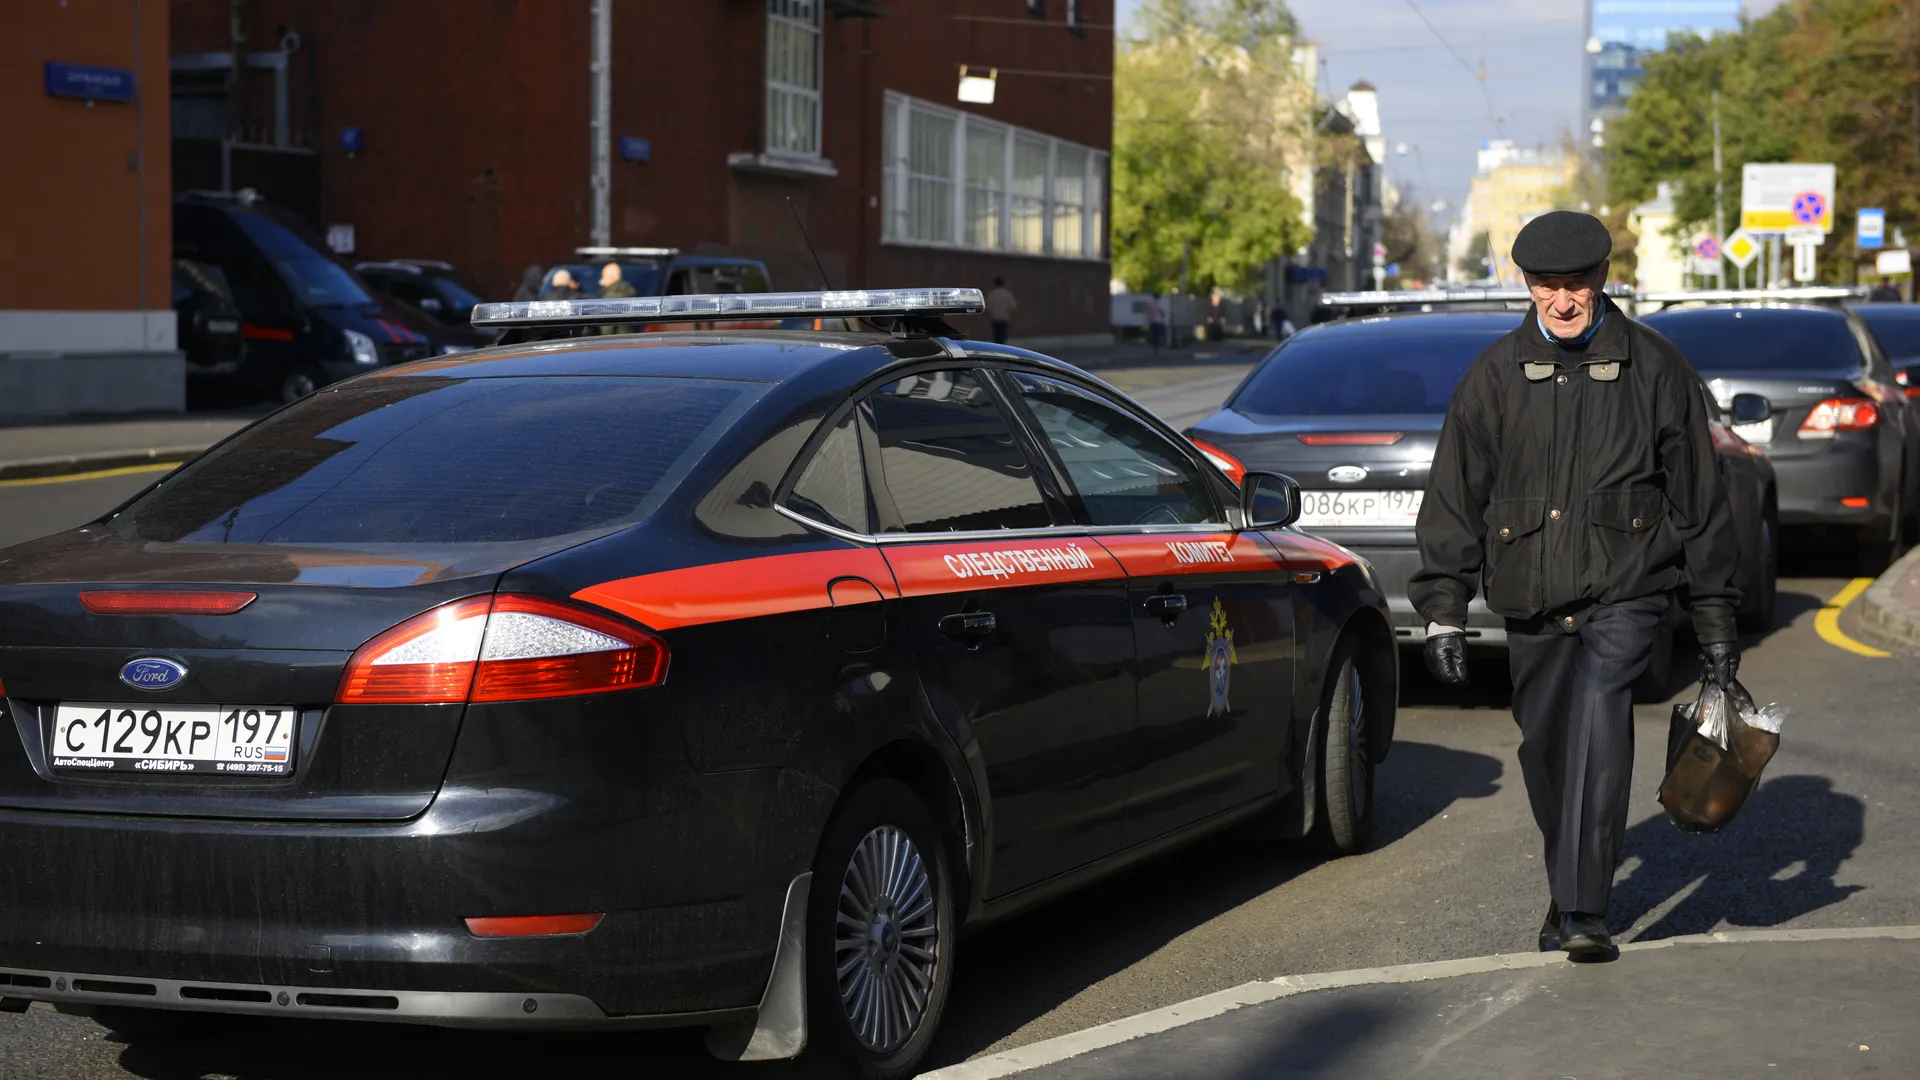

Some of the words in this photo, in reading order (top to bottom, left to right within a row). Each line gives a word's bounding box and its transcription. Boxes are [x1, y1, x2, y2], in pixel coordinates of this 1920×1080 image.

[1301, 490, 1375, 515] 086КР
[1382, 488, 1416, 510] 197
[943, 542, 1095, 581] СЛЕДСТВЕННЫЙ
[1166, 541, 1235, 564] КОМИТЕТ
[132, 663, 170, 682] Ford
[66, 709, 211, 755] С129КР
[224, 709, 283, 744] 197
[233, 746, 263, 759] RUS
[53, 757, 115, 769] АвтоСпецЦентр
[226, 763, 246, 772] (495)
[246, 764, 284, 773] 207-75-15
